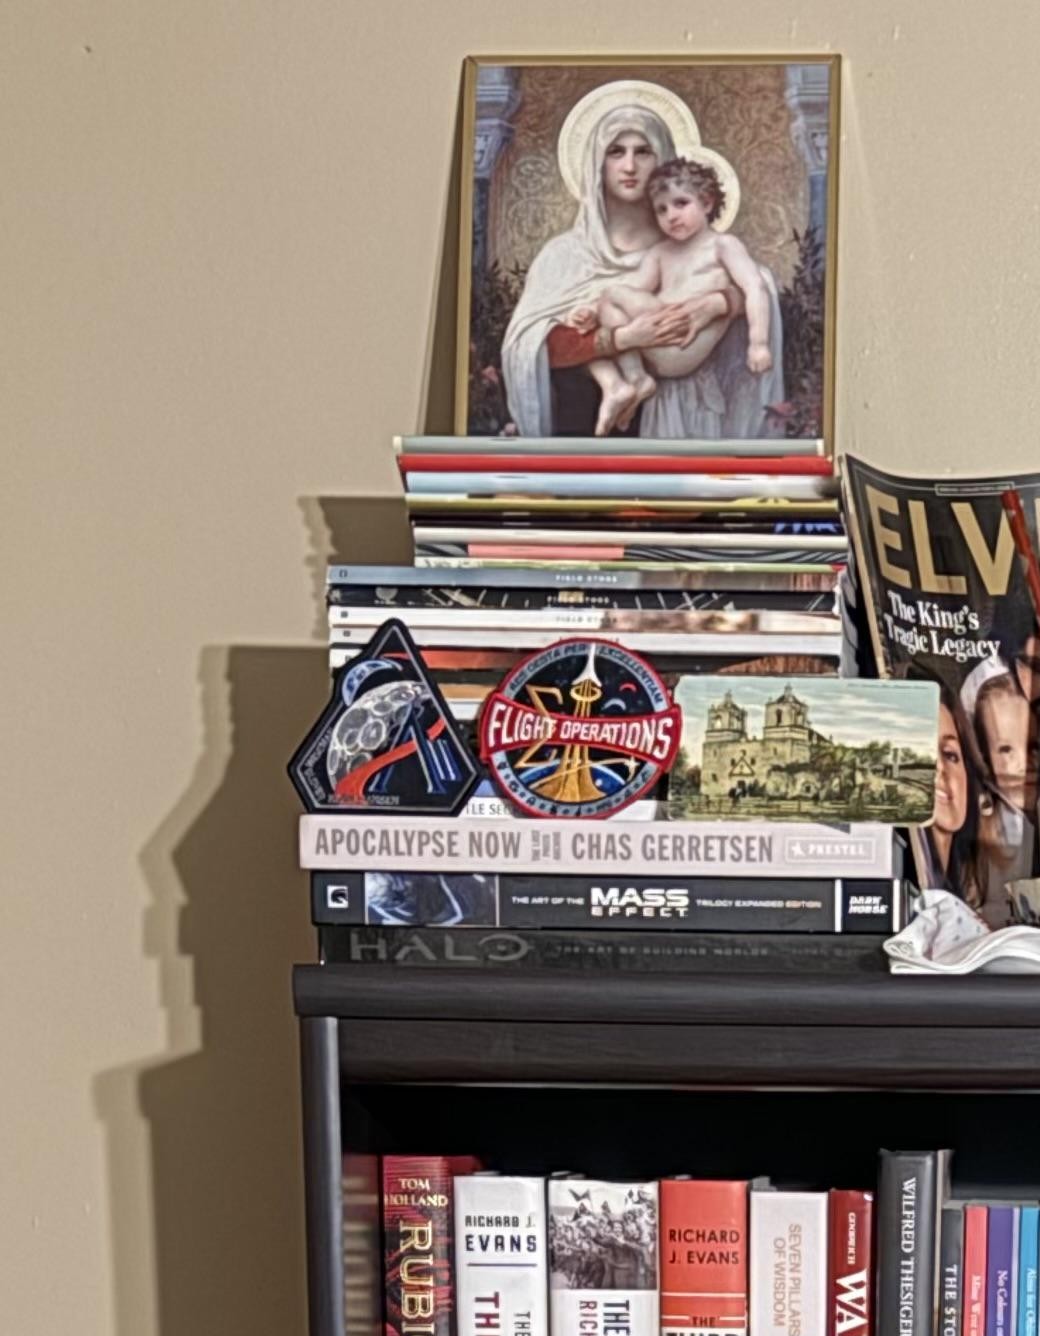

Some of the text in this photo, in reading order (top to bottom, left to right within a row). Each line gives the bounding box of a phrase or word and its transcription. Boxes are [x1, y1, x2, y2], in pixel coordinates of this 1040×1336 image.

[887, 590, 979, 633] The King's
[884, 615, 1000, 663] Tragic Legacy
[489, 703, 673, 760] FLIGHT OPERATIONS
[315, 829, 520, 859] APOCALYPSE NOW
[572, 833, 631, 861] CHAS
[641, 834, 773, 863] GERRETSEN
[512, 896, 528, 904] THE
[567, 897, 585, 905] THE
[591, 887, 689, 906] MASS
[697, 898, 732, 907] TRILOGY
[735, 899, 783, 908] EXPANDED
[849, 895, 882, 905] DARK
[591, 907, 688, 918] EFFECT
[849, 904, 887, 914] HORSE
[349, 933, 529, 962] HALO
[400, 1179, 430, 1192] TOM
[384, 1194, 448, 1207] HOLLAND
[465, 1215, 519, 1228] RICHARD
[900, 1177, 916, 1254] WILFRED
[465, 1235, 537, 1253] EVANS
[669, 1229, 740, 1243] RICHARD
[669, 1250, 740, 1265] J. EVANS
[603, 1299, 629, 1336] THE
